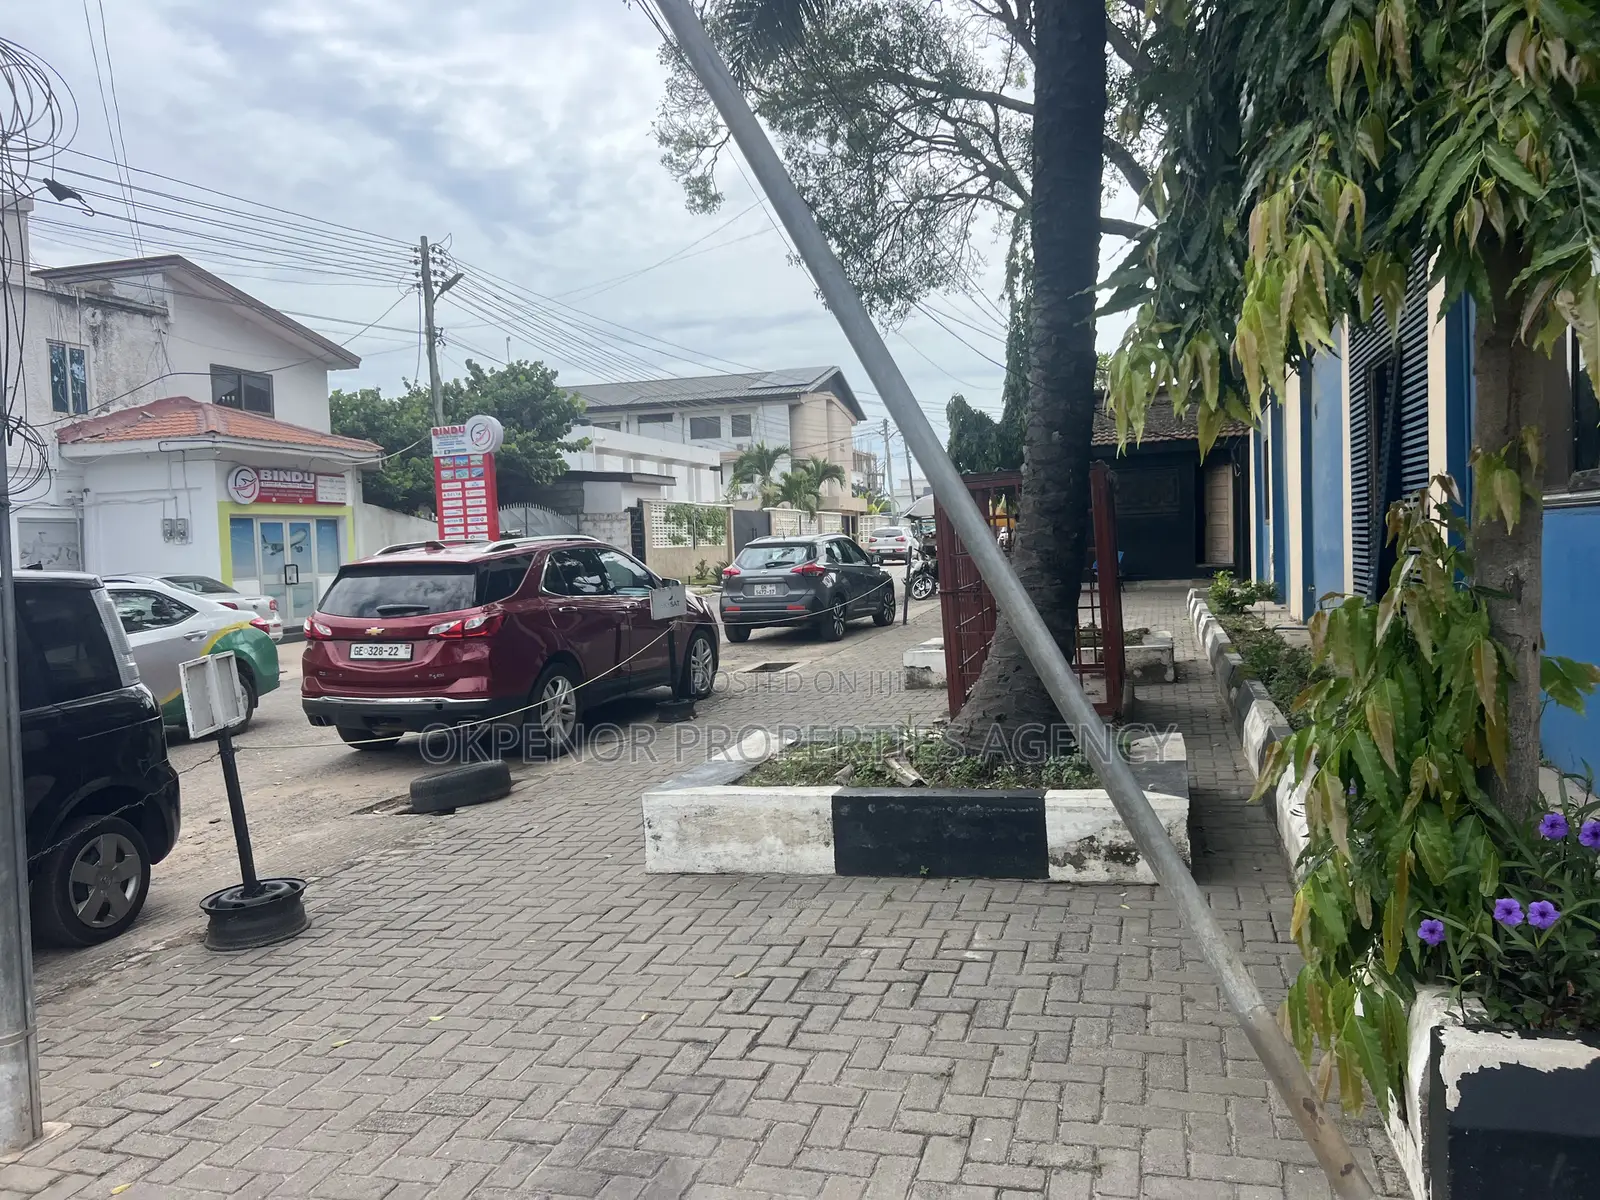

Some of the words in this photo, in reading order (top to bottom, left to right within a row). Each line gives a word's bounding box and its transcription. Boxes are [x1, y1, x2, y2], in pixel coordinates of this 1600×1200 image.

[432, 425, 466, 436] BINDU
[259, 469, 315, 483] BINDU
[354, 646, 364, 656] GE
[368, 646, 399, 656] 328-22
